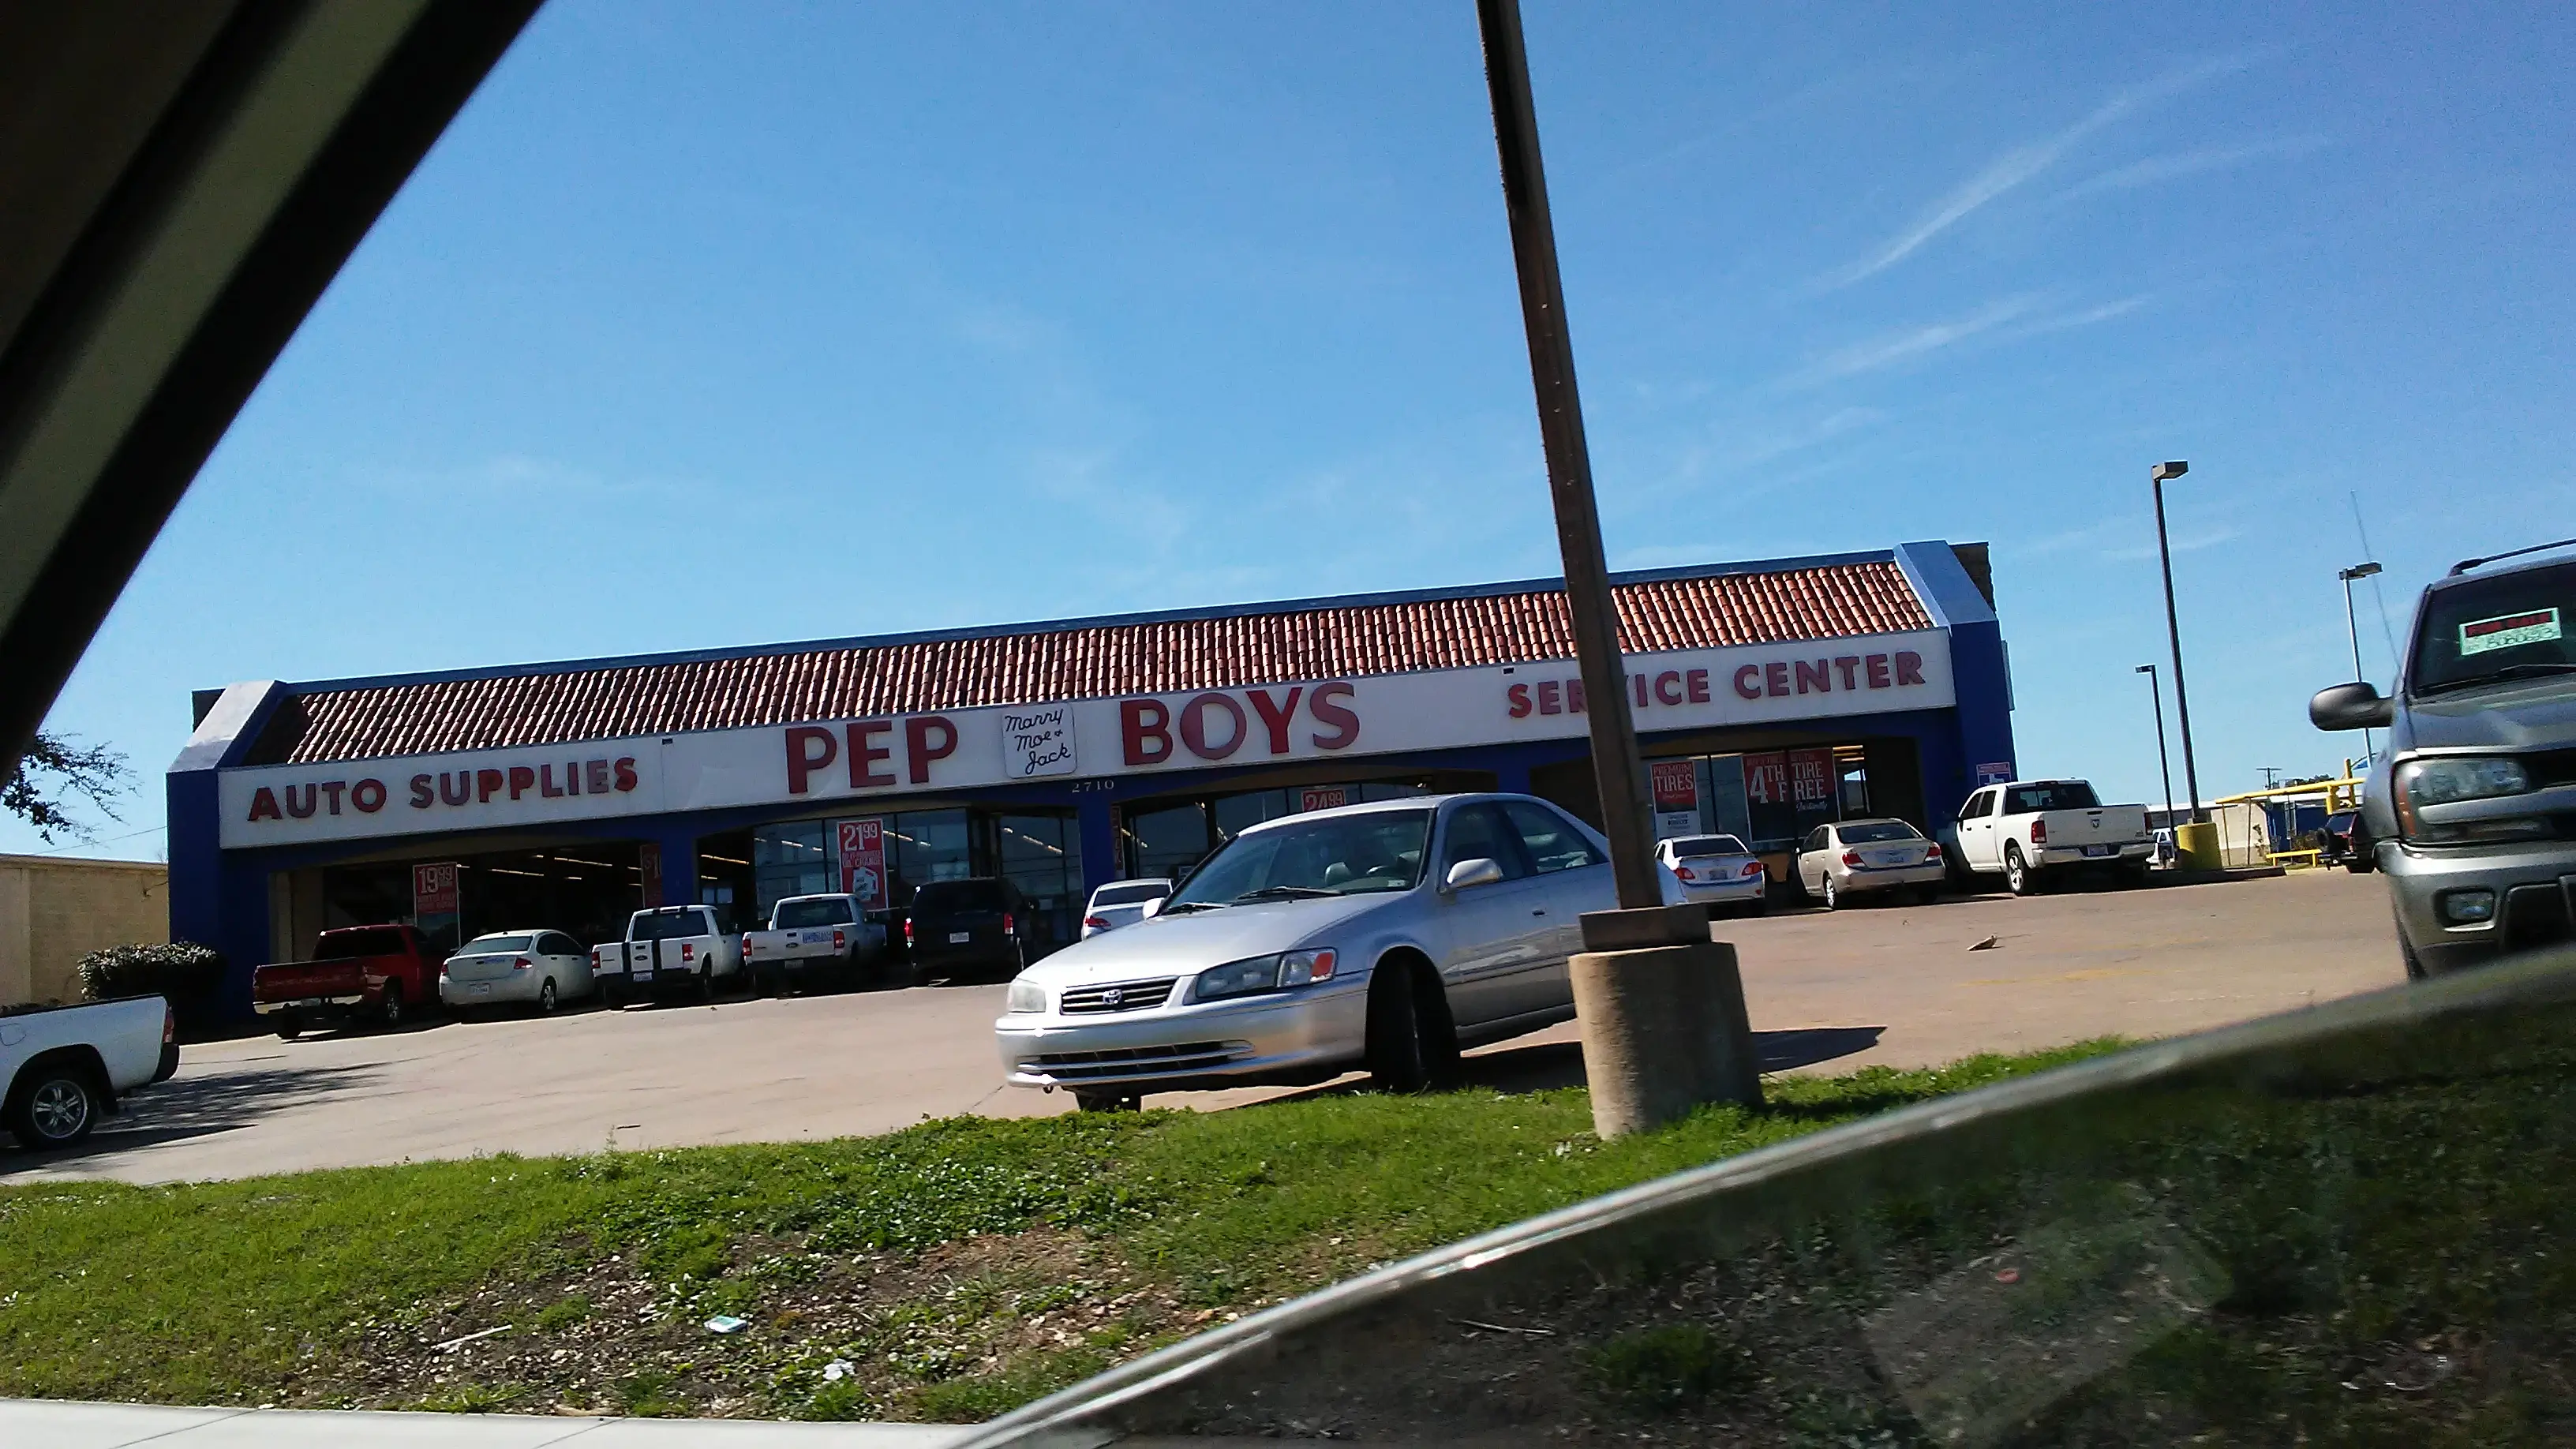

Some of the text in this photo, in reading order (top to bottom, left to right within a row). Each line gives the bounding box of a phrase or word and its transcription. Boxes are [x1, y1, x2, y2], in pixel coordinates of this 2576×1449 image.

[1507, 650, 1926, 718] SERICE CENTER
[785, 682, 1361, 794] PEP BOYS
[1014, 731, 1052, 751] Moe
[1025, 742, 1072, 775] Jack
[1791, 761, 1824, 780] TIRE
[246, 756, 638, 822] AUTO SUPPLIES
[1072, 780, 1114, 793] 2710
[1654, 773, 1694, 792] TIRES
